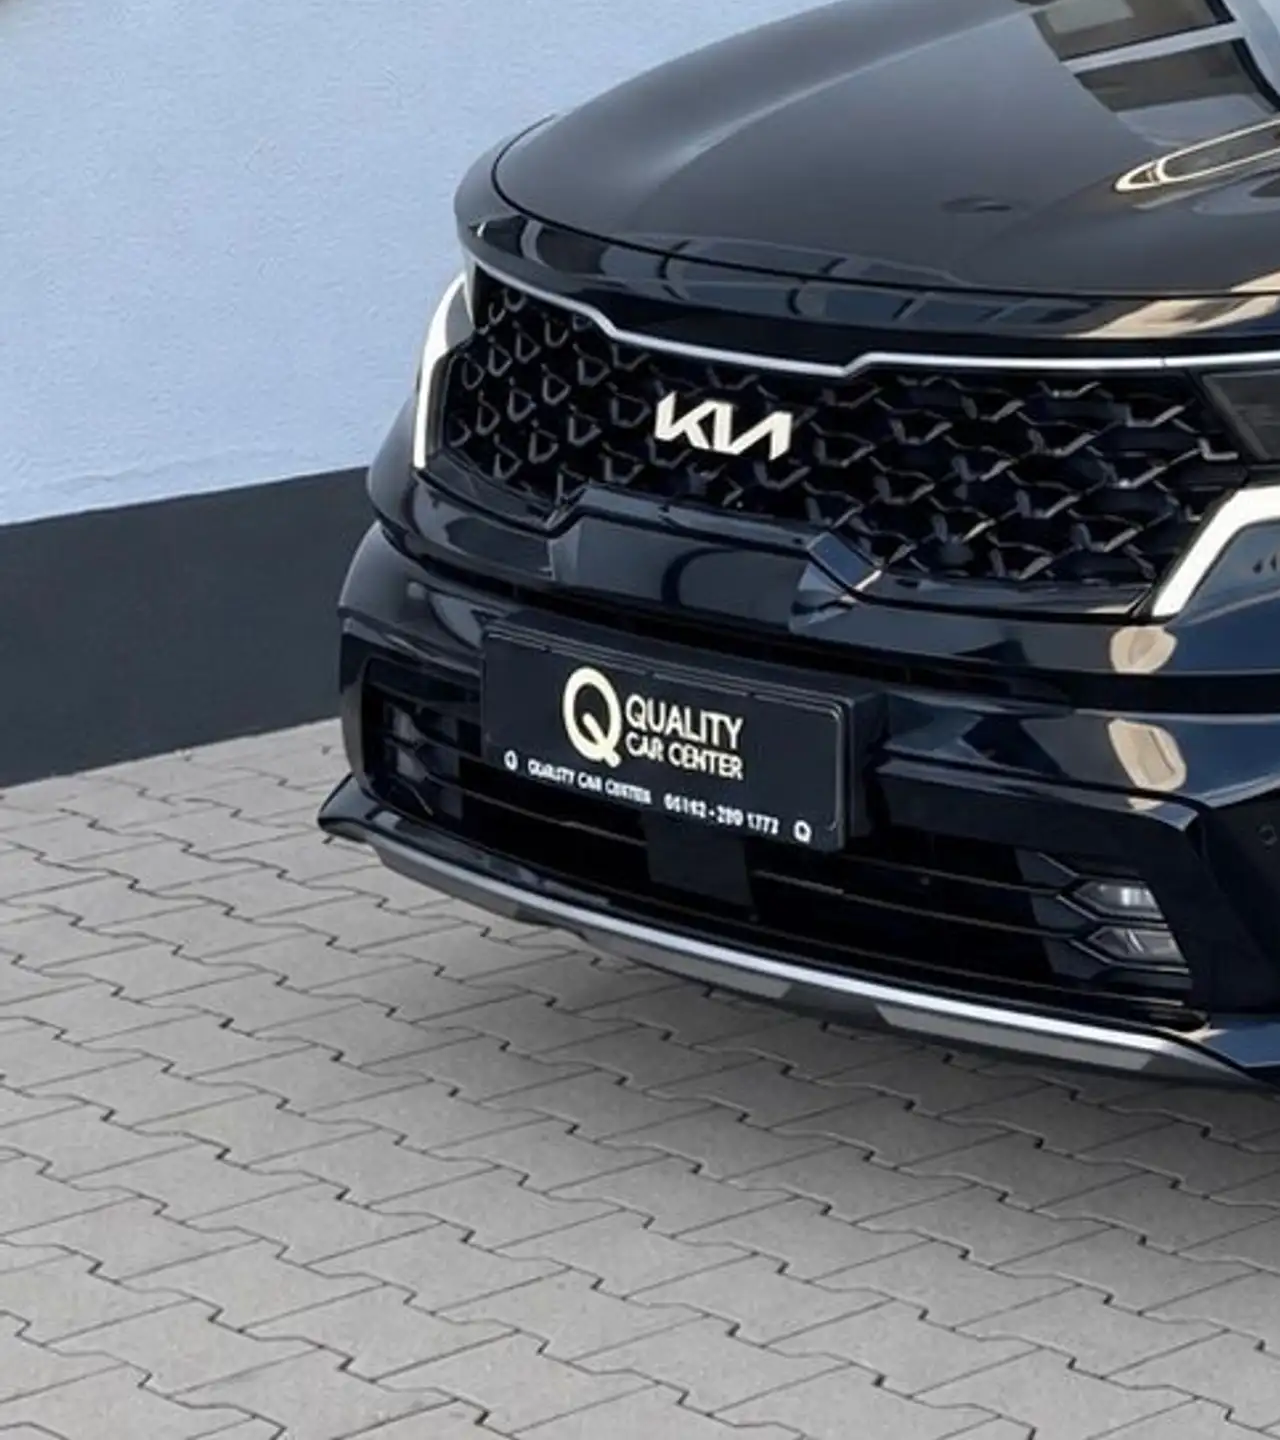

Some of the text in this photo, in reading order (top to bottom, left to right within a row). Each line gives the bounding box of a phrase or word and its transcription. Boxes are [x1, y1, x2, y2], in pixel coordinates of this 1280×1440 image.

[562, 666, 623, 768] Q
[625, 693, 744, 750] QUALITY
[625, 731, 744, 781] CAR CENTER
